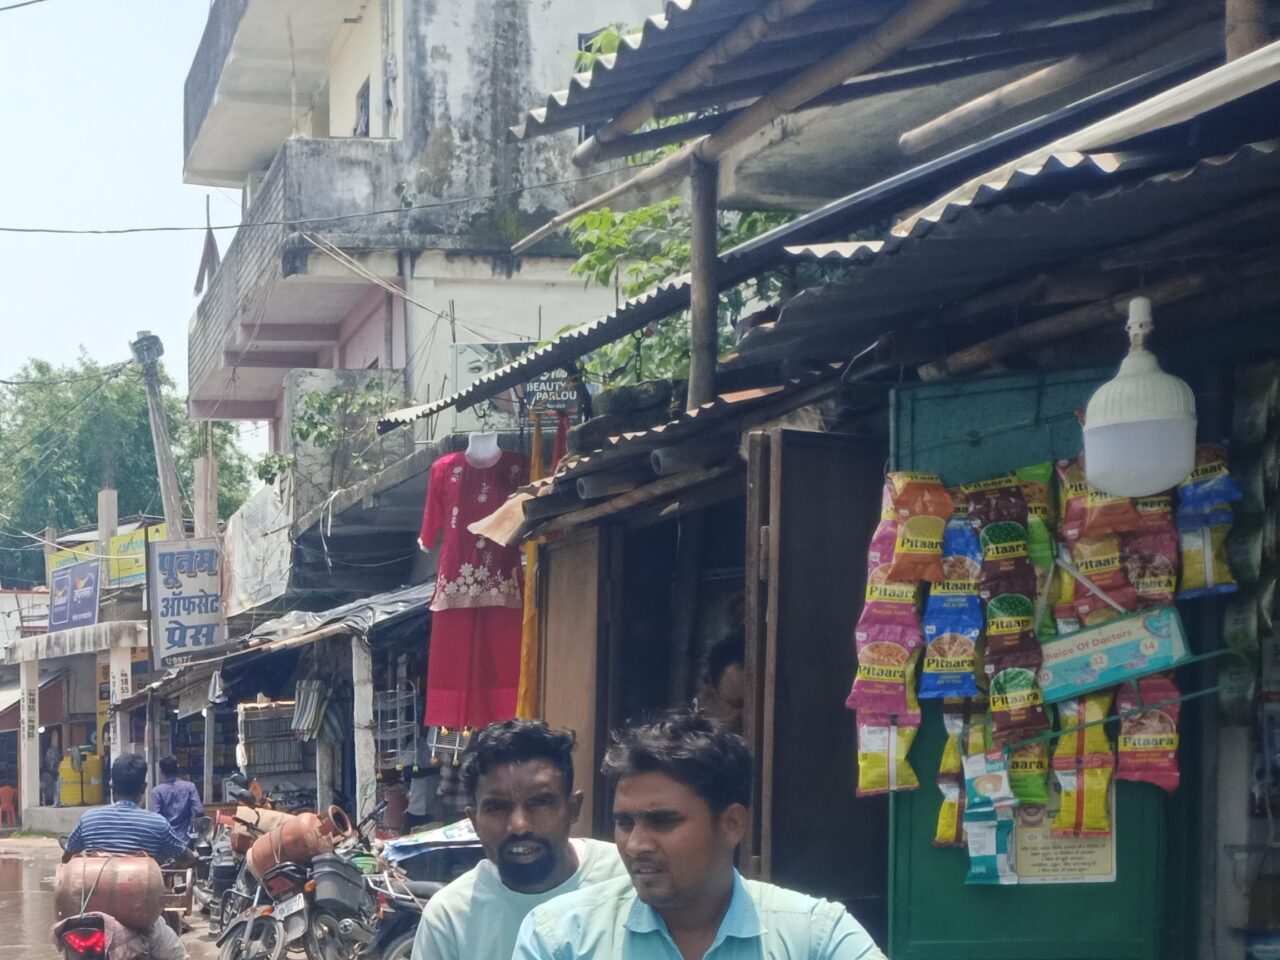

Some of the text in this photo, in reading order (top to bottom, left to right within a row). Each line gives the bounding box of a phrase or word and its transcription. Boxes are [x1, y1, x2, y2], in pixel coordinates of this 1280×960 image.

[526, 381, 566, 392] BEAUTY
[158, 549, 219, 589] पूनम
[160, 589, 221, 618] ऑफसेट
[165, 620, 220, 651] प्रेस
[1076, 640, 1090, 651] Of
[1092, 630, 1133, 646] Doctors
[1144, 642, 1155, 650] 14
[927, 658, 975, 668] Pitaara
[1093, 656, 1104, 665] 12
[992, 691, 1039, 707] Pitaara
[1123, 736, 1175, 747] Pitaara
[1010, 760, 1044, 770] aara
